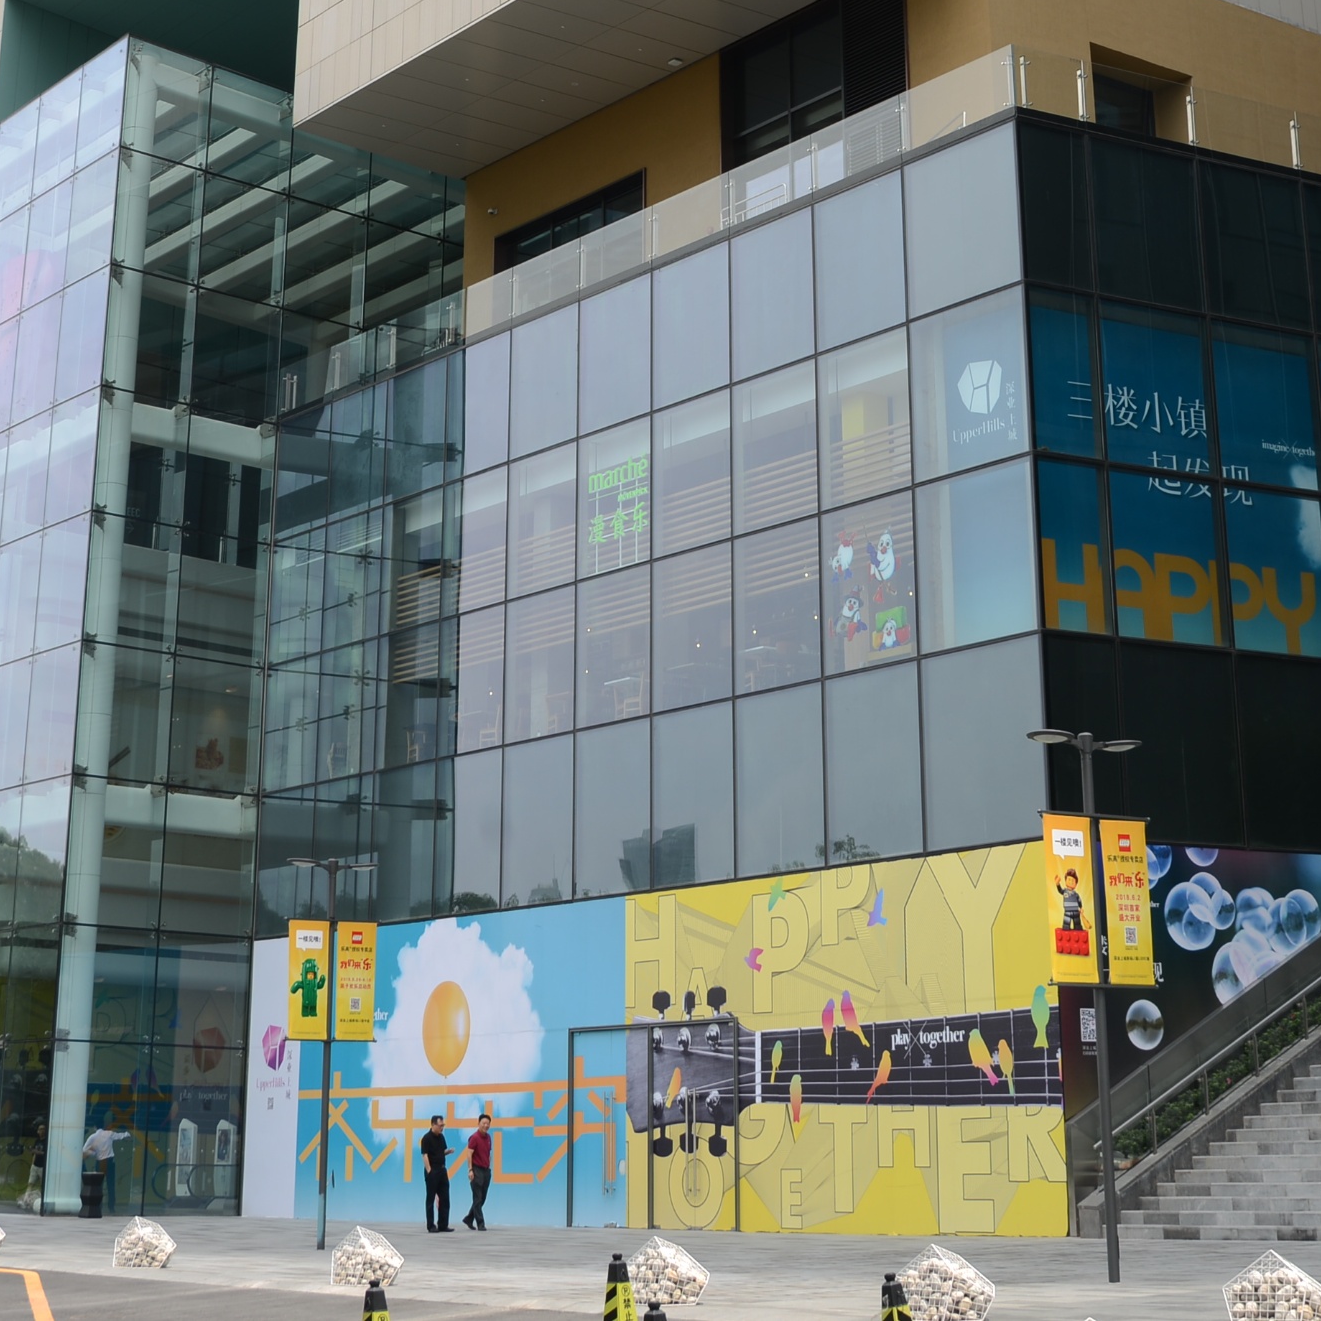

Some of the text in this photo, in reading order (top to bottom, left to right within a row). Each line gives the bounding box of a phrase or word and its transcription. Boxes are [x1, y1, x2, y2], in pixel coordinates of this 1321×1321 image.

[952, 417, 1006, 444] UpperHills
[1005, 381, 1018, 440] 深业上城
[1066, 380, 1208, 439] 三楼小镇
[588, 451, 648, 494] marché
[1291, 446, 1316, 458] togeth
[588, 501, 648, 545] 漫食乐
[1040, 537, 1318, 655] HAPPY
[891, 1026, 966, 1051] play together
